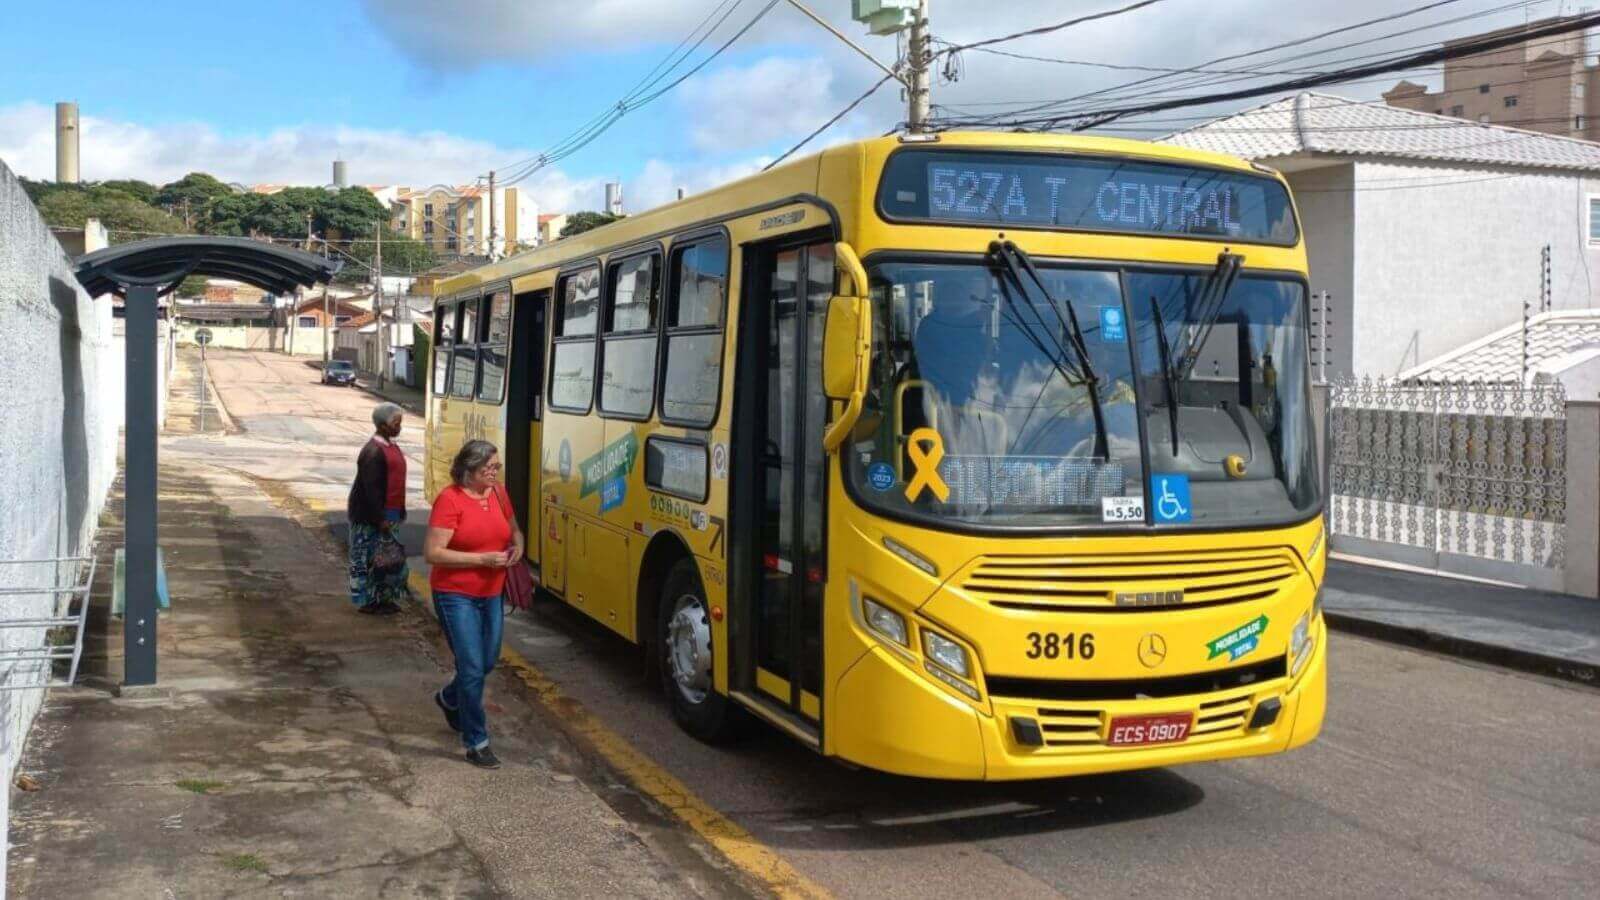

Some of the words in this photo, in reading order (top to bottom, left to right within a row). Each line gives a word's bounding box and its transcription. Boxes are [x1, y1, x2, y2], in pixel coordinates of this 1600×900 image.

[933, 169, 1028, 217] 527A
[1045, 176, 1067, 226] T
[1097, 181, 1240, 232] CENTRAL
[873, 473, 891, 482] 2023
[1025, 631, 1095, 660] 3816
[1215, 619, 1261, 653] MOBILIDADE
